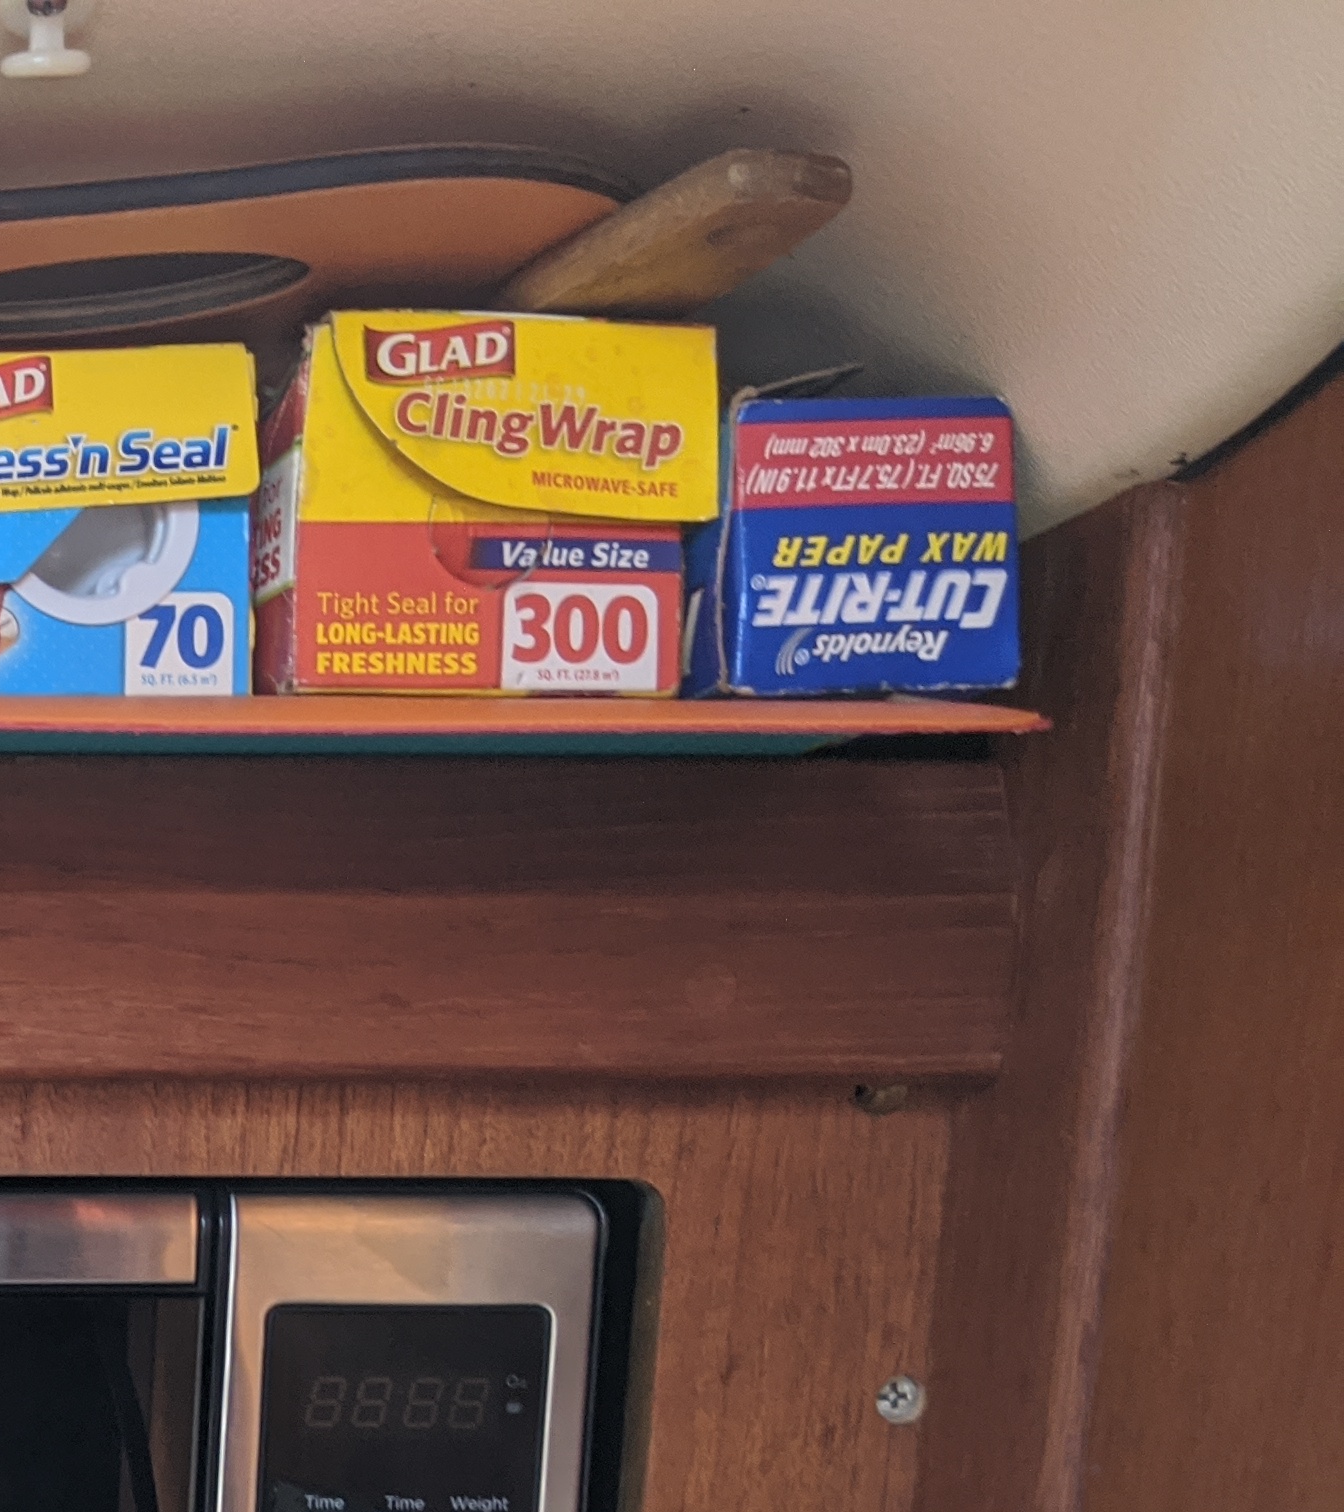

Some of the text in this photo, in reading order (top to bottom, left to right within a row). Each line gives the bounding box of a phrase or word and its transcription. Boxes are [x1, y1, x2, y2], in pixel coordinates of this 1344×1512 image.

[377, 331, 508, 377] GLAD
[119, 424, 230, 476] Seal
[531, 470, 679, 499] MICROWAVE-SAFE
[501, 541, 649, 569] Value Size
[772, 531, 1008, 568] WAX PAPER
[317, 590, 479, 620] Tight Seal for
[752, 568, 1008, 629] CUT-RITE
[137, 602, 224, 670] 70
[316, 621, 480, 646] LONG-LASTING
[512, 592, 648, 665] 300
[813, 624, 949, 662] Reynolds
[316, 651, 478, 675] FRESHNESS
[305, 1494, 345, 1510] Time
[385, 1495, 426, 1511] Time
